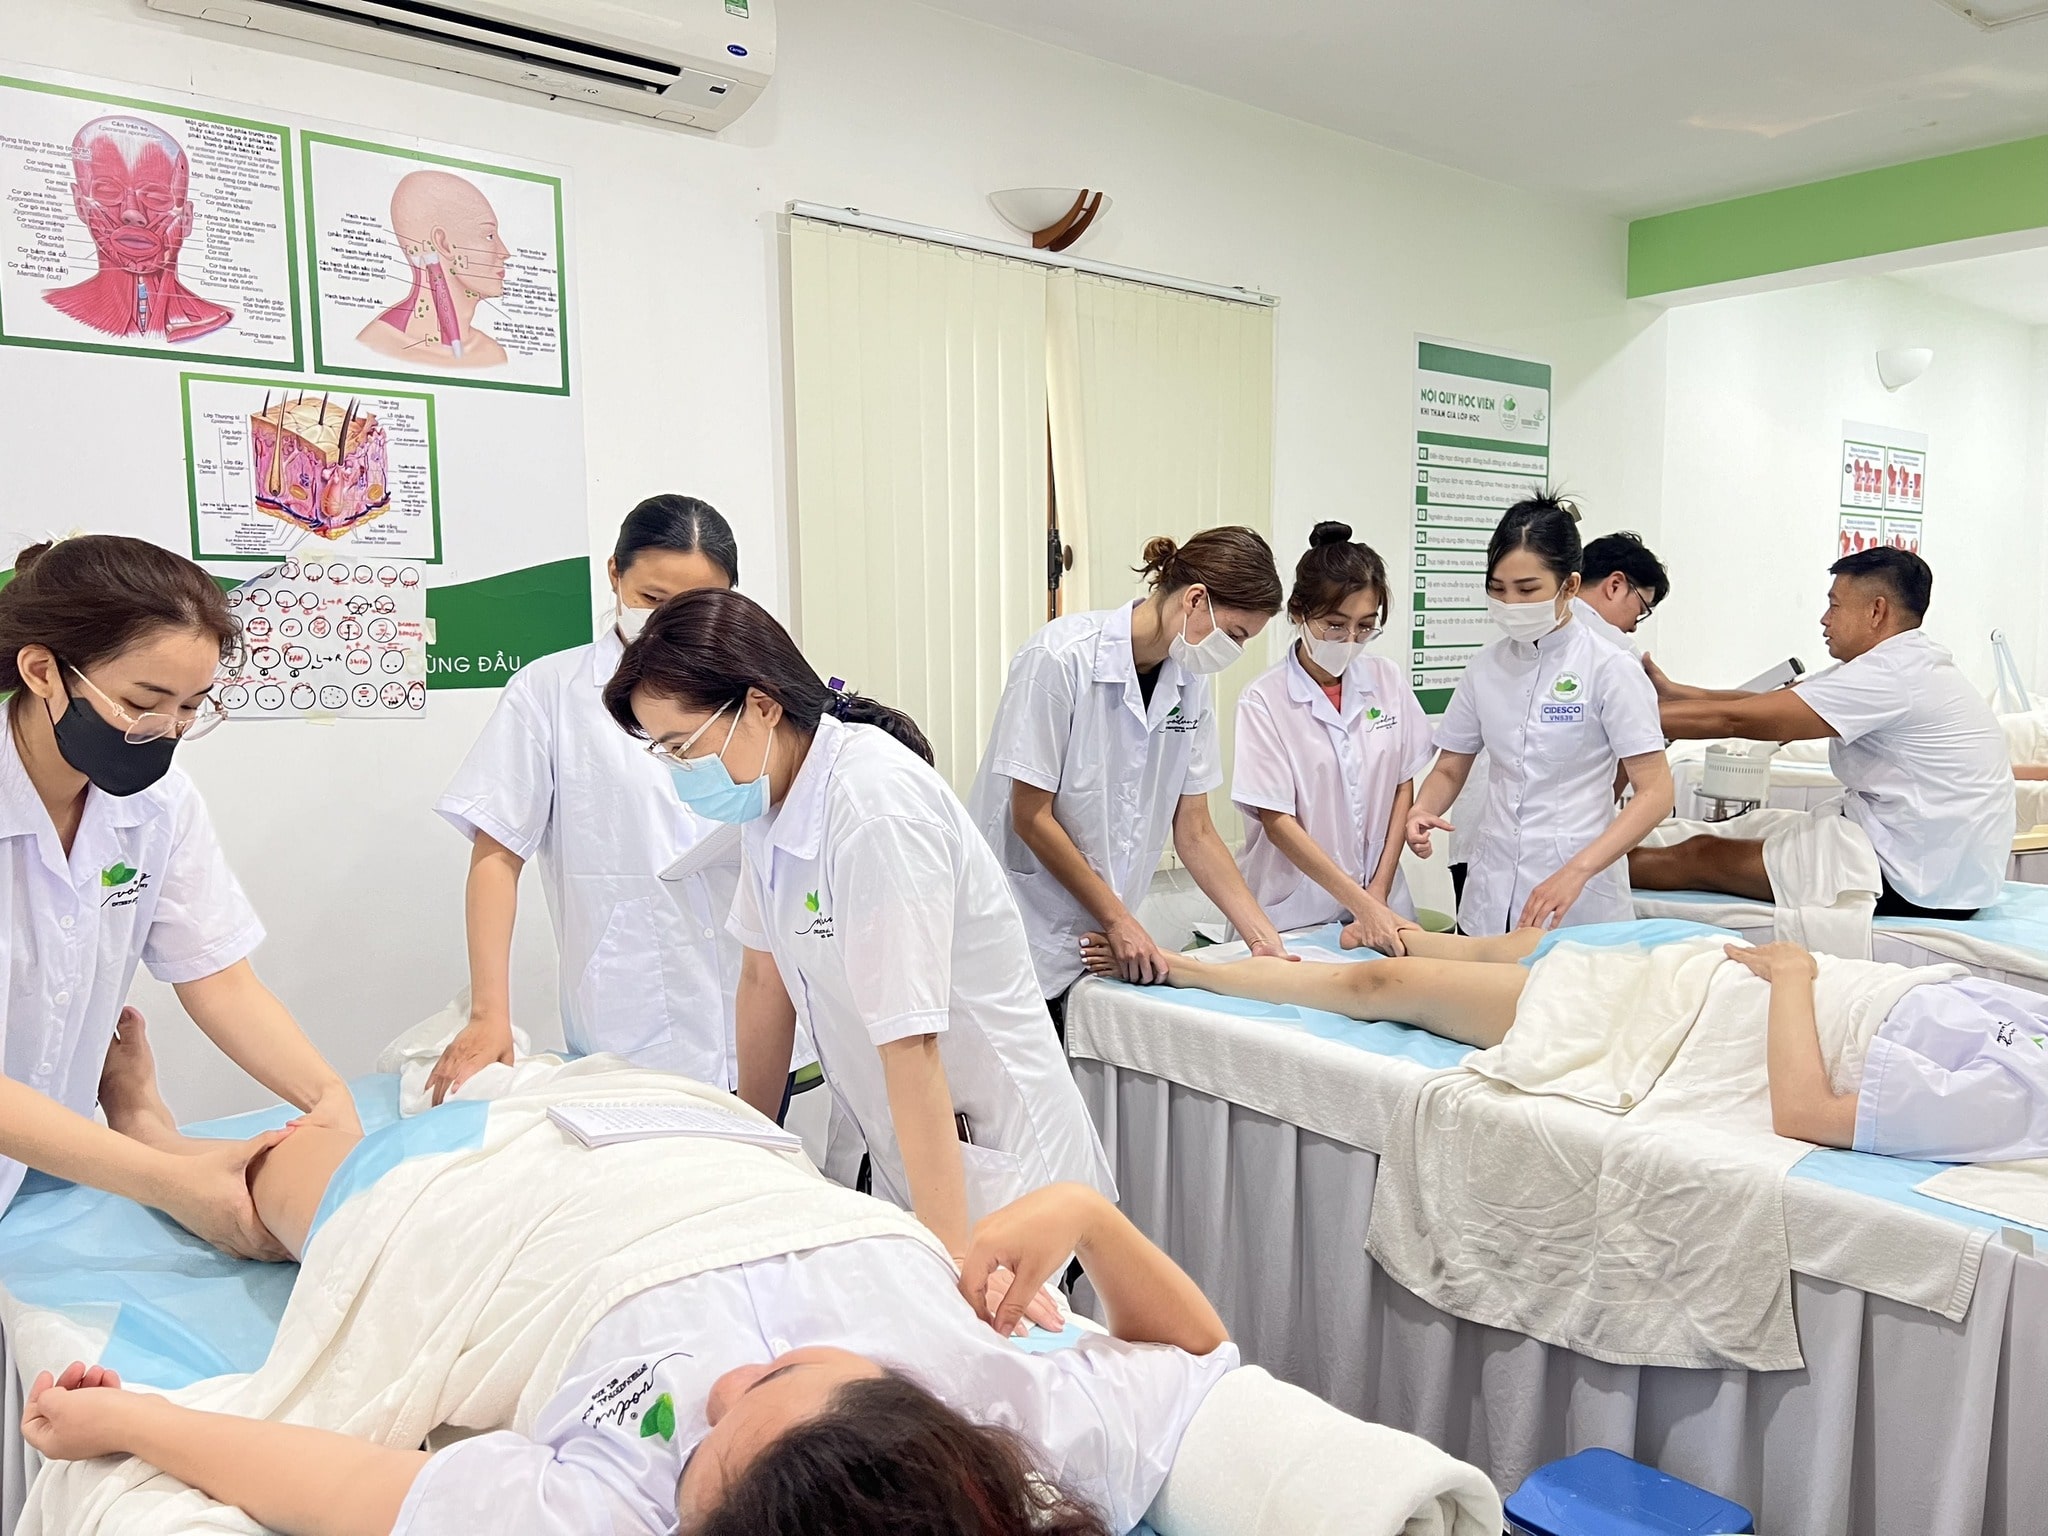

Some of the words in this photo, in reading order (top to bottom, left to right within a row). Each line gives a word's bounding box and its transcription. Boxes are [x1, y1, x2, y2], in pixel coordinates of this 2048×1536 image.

[1438, 391, 1457, 405] QUY
[1458, 395, 1476, 408] HỌC
[478, 650, 521, 671] ĐẦU
[1544, 706, 1580, 714] CIDESCO
[597, 1363, 648, 1406] INTERNATIONAL
